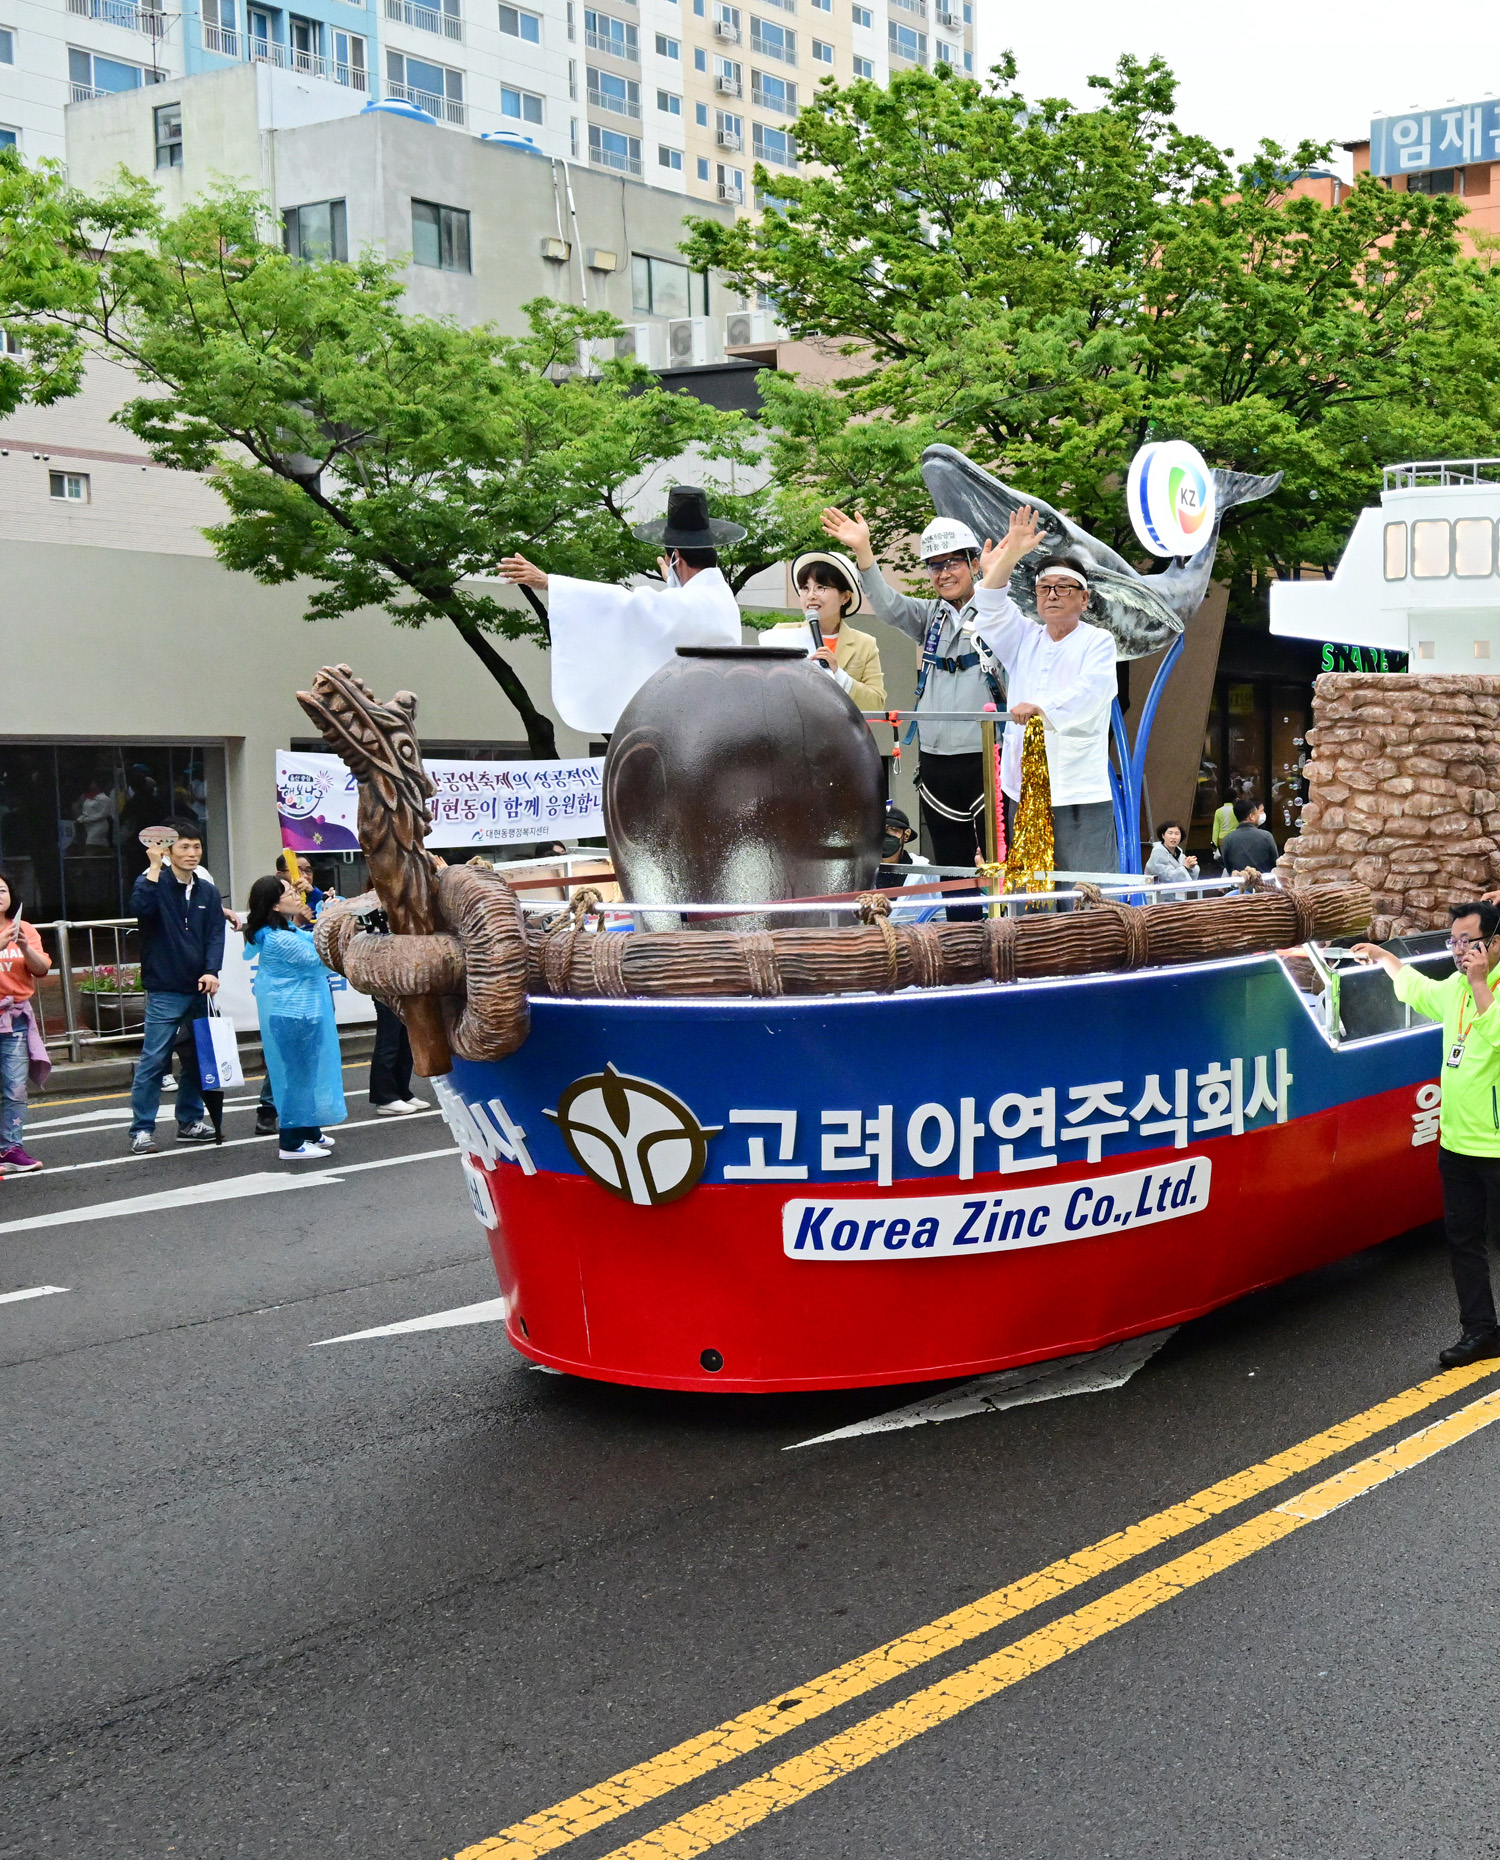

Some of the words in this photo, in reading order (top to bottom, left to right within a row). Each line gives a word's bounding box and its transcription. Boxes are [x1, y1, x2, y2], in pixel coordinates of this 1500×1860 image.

[1180, 487, 1196, 507] KZ
[533, 766, 602, 789] 성공적인
[280, 783, 325, 807] 행복남구
[503, 795, 540, 818] 함께
[485, 825, 549, 839] 대현동행정복지센터
[722, 1047, 1294, 1187] 고려아연주식회사
[793, 1207, 939, 1252] Korea
[952, 1198, 1048, 1246] Zinc
[1064, 1166, 1199, 1232] Co.,Ltd.
